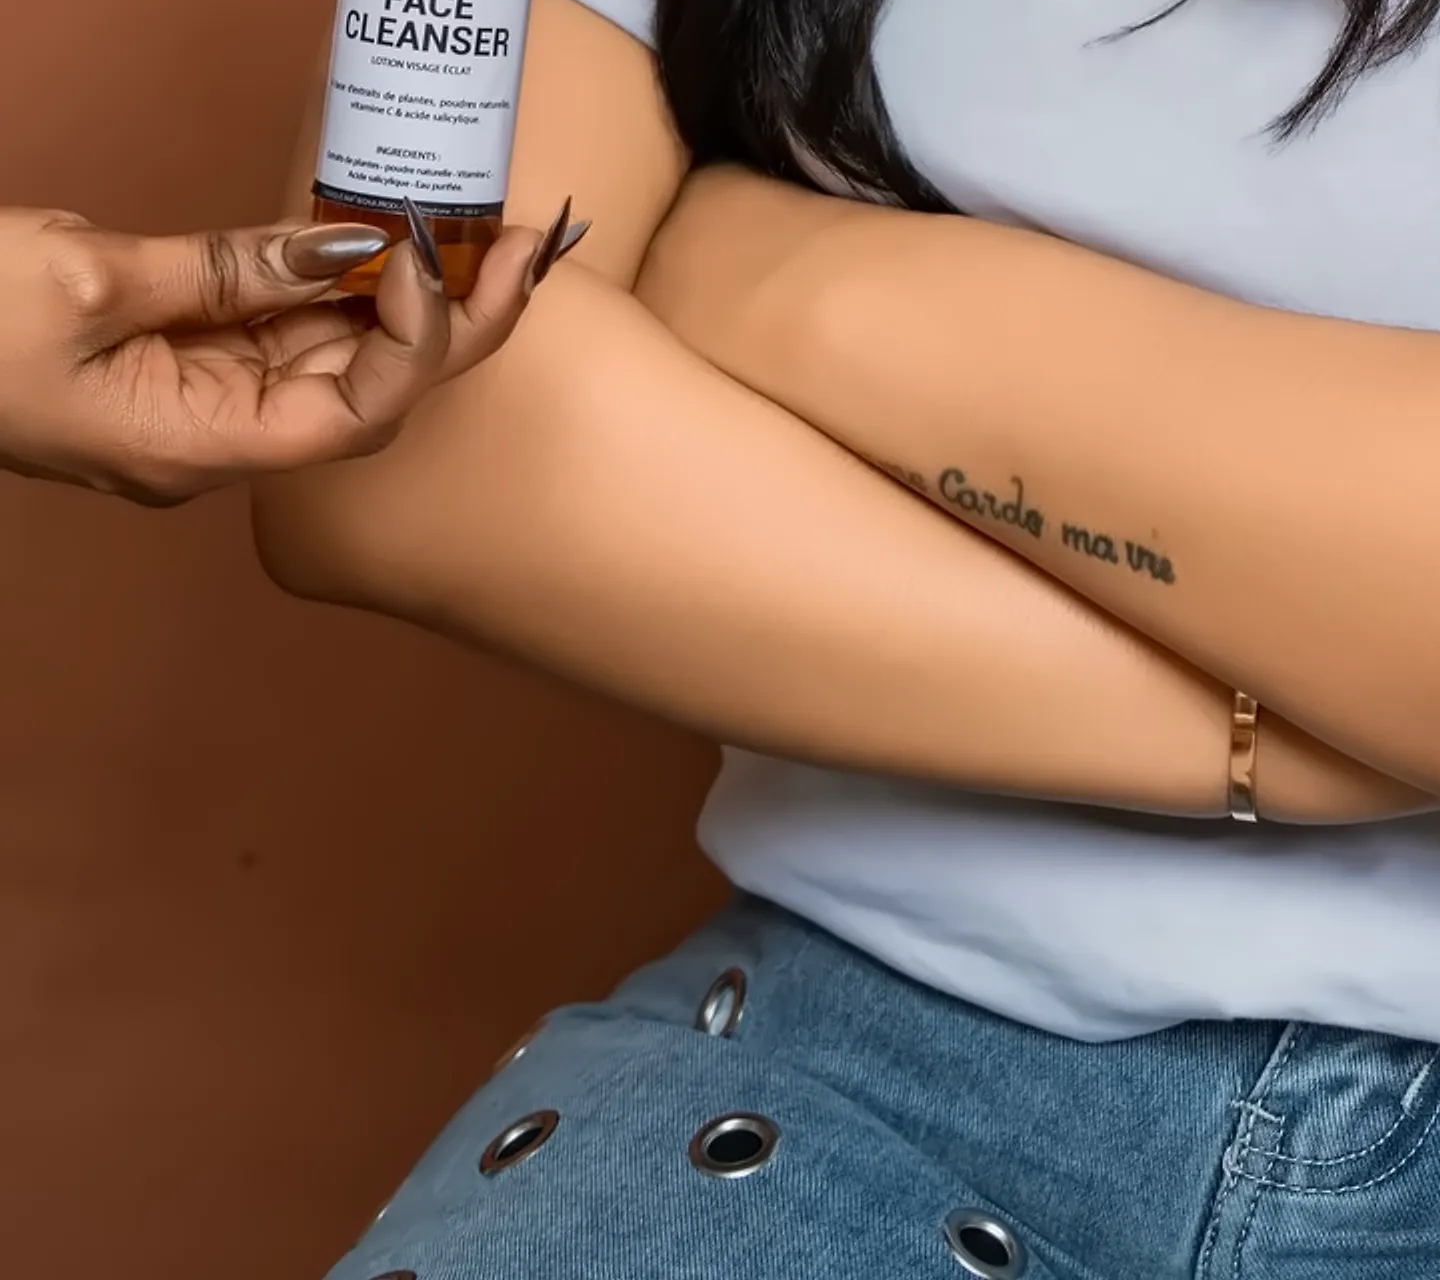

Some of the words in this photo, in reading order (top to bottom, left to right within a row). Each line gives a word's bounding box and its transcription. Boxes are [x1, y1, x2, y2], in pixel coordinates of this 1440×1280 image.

[345, 9, 510, 58] CLEANSER
[370, 55, 404, 68] LOTION
[406, 60, 440, 74] VISAGE
[383, 90, 396, 101] de
[397, 93, 437, 108] plantes,
[439, 97, 477, 109] poudres
[349, 100, 386, 114] vitamine
[386, 106, 393, 115] C
[394, 107, 402, 118] &
[404, 109, 431, 121] acide
[348, 170, 367, 182] Acide
[415, 179, 431, 189] Eau
[1061, 521, 1119, 565] ma
